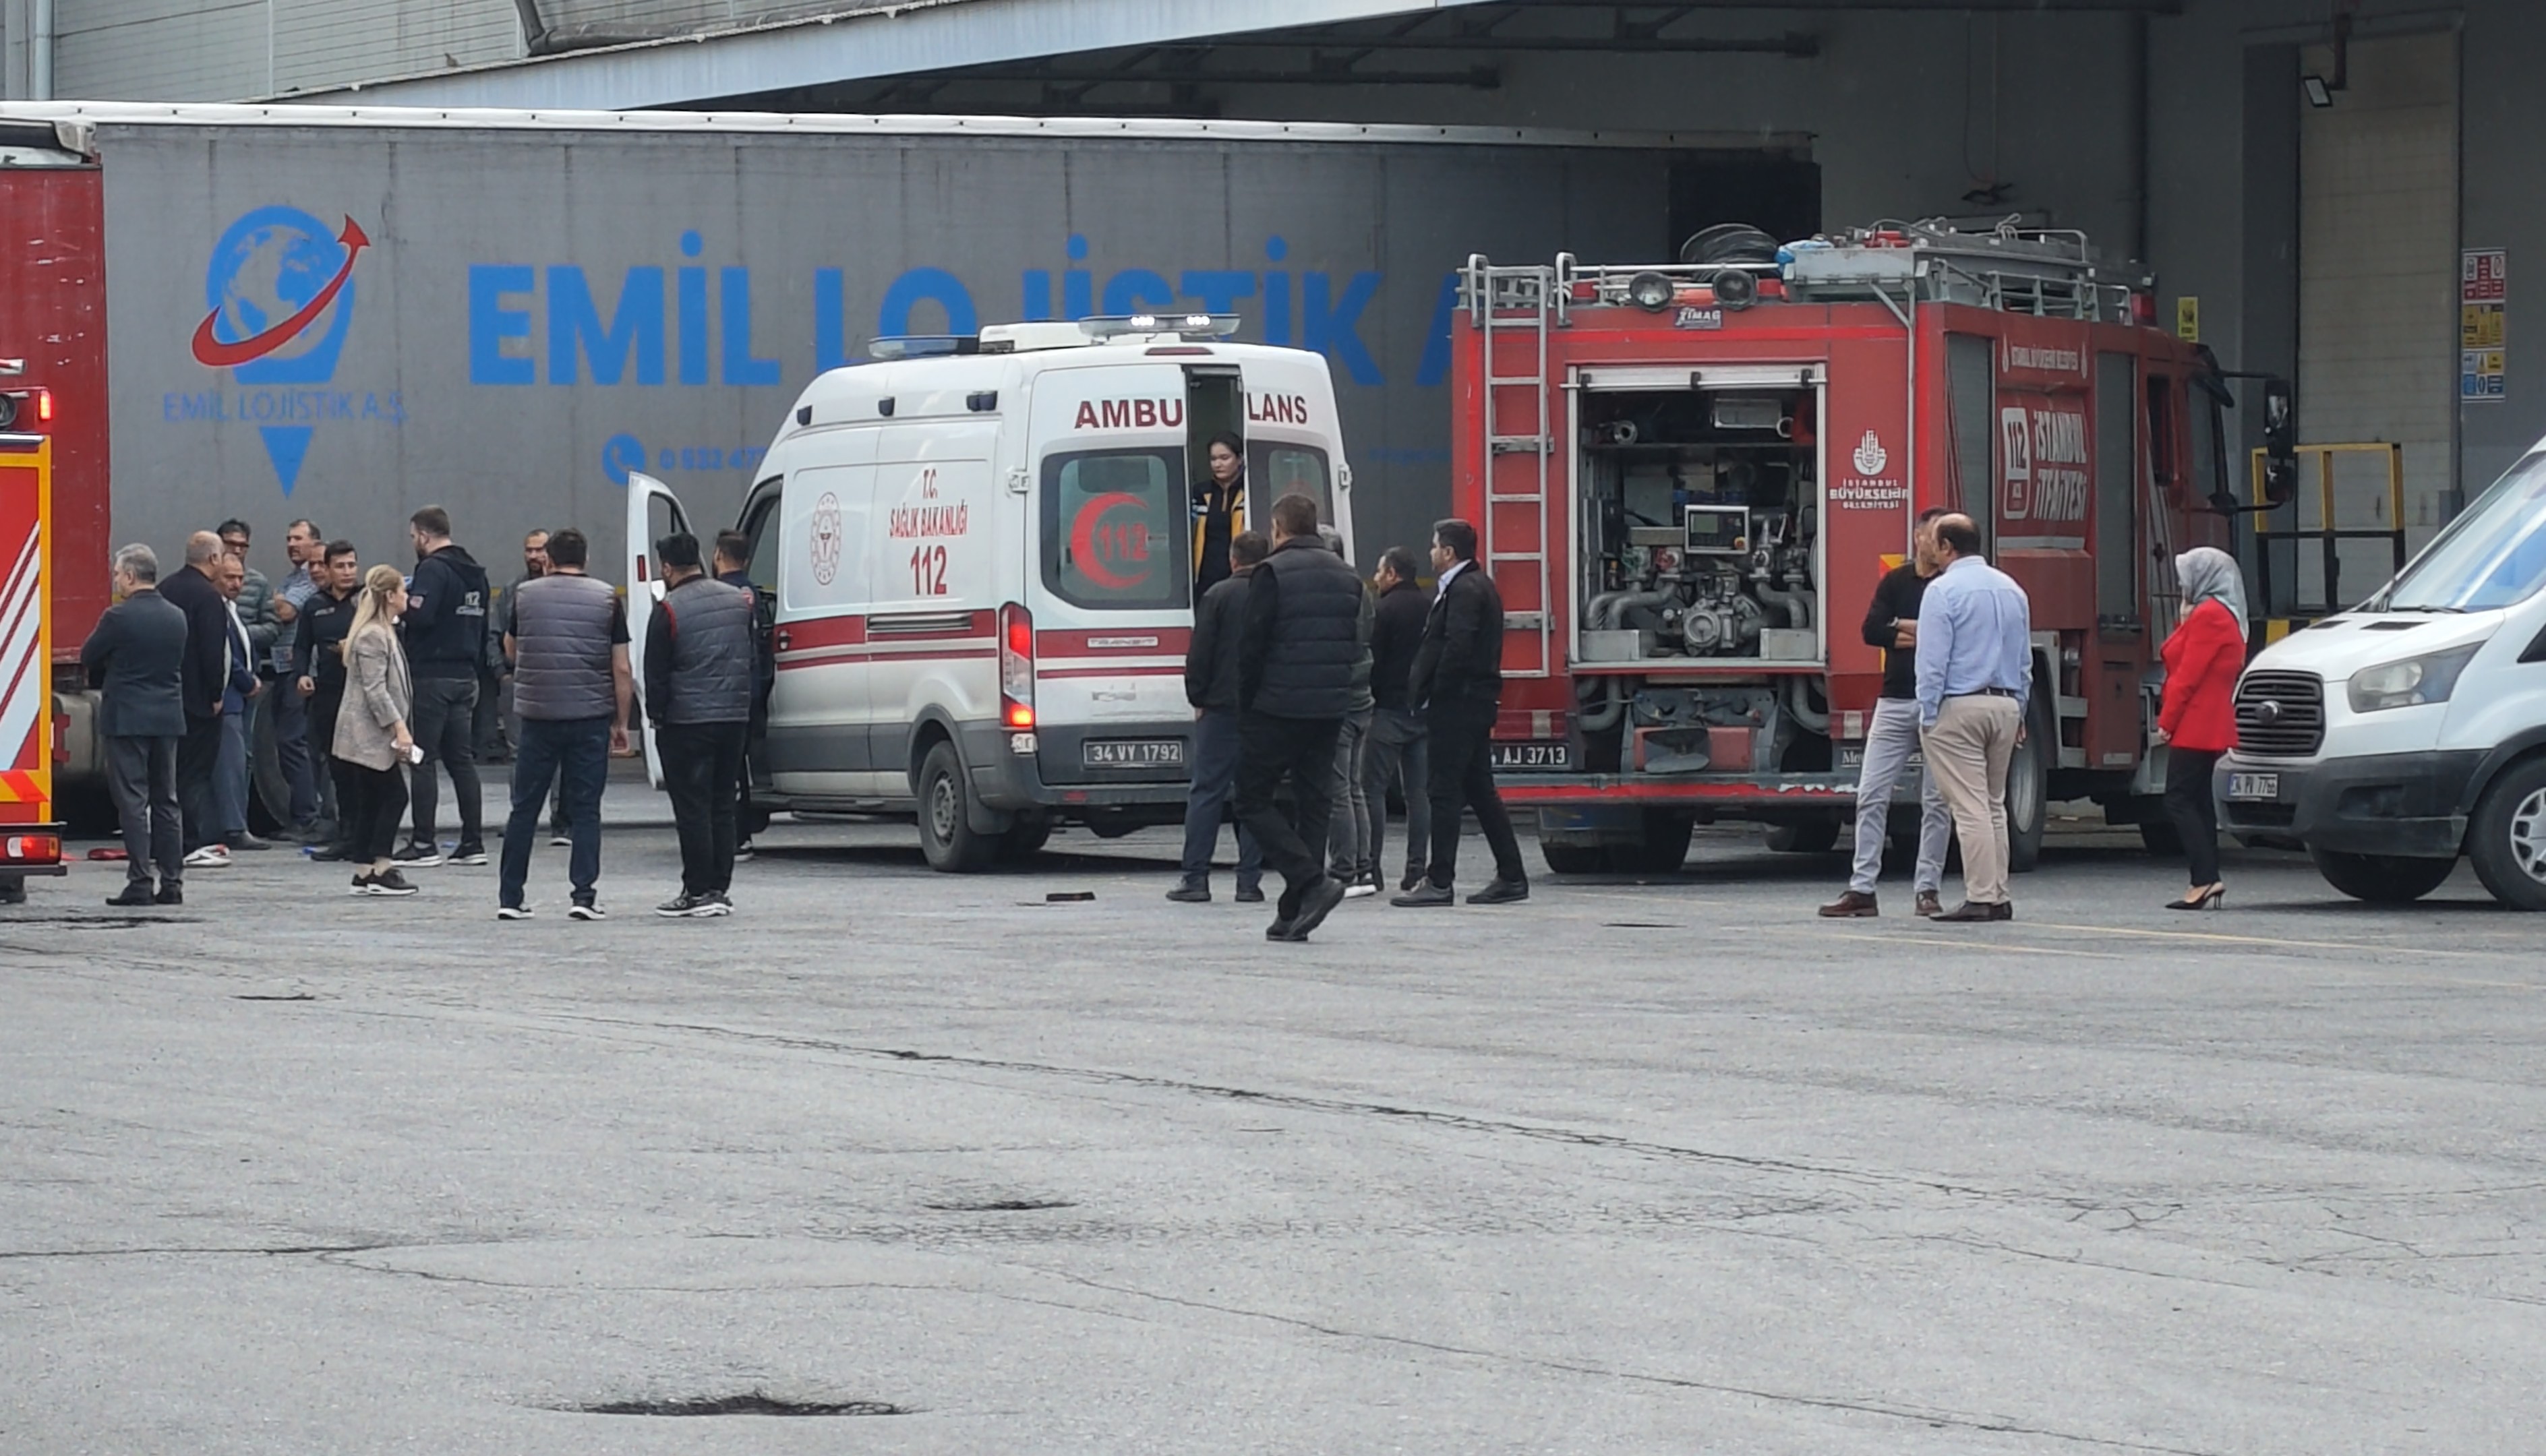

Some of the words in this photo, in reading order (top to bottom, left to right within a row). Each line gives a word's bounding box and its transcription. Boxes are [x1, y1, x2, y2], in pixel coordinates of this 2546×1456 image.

[469, 229, 780, 386] EMİL
[164, 388, 230, 422] EMİL
[239, 386, 354, 421] LOJİSTİK
[1075, 399, 1183, 429] AMBU
[1247, 393, 1307, 424] LANS
[2007, 421, 2027, 469] 112
[2034, 409, 2088, 464] İSTANBUL
[1098, 523, 1150, 562] 112
[910, 545, 947, 595] 112
[1094, 746, 1113, 761] 34
[1117, 745, 1135, 760] VY
[1142, 744, 1179, 760] 1792
[1503, 746, 1521, 765] AJ
[1527, 746, 1565, 764] 3713
